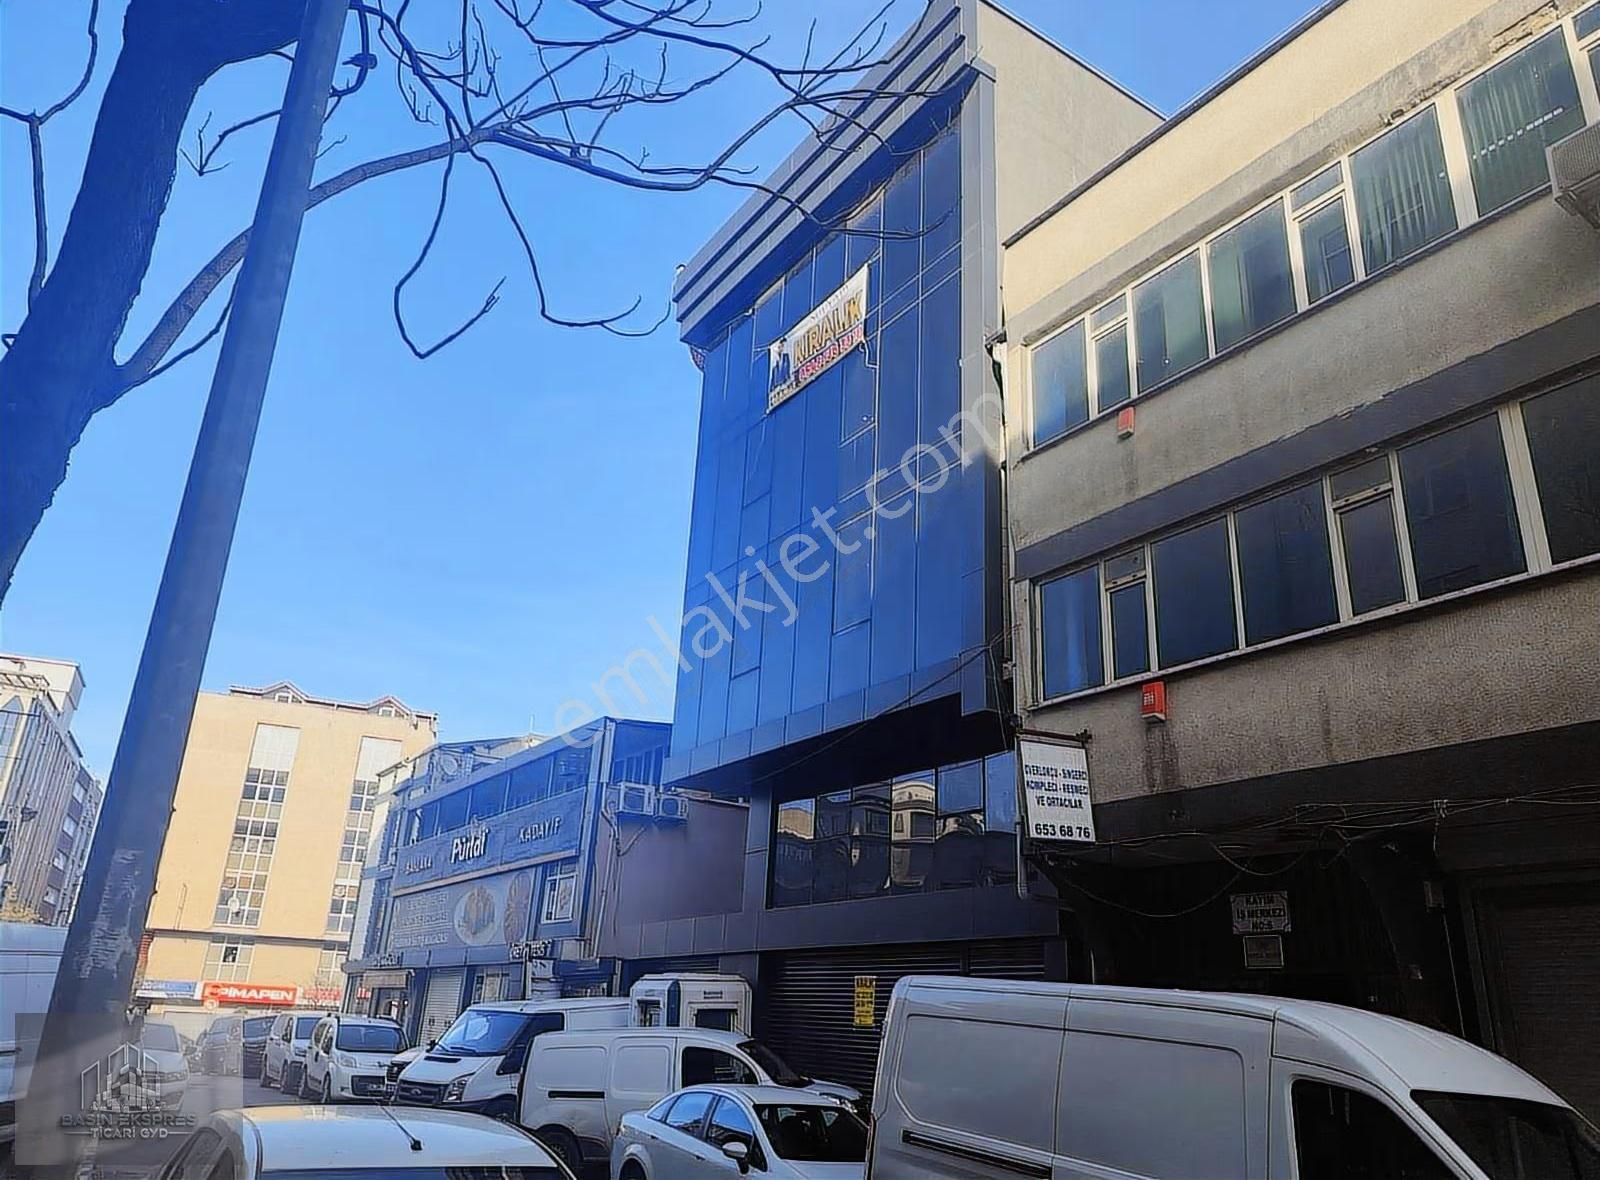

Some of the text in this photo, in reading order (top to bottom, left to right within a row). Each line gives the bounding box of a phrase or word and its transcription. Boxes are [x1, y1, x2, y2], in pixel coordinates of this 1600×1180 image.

[1035, 823, 1091, 838] 653 68 76
